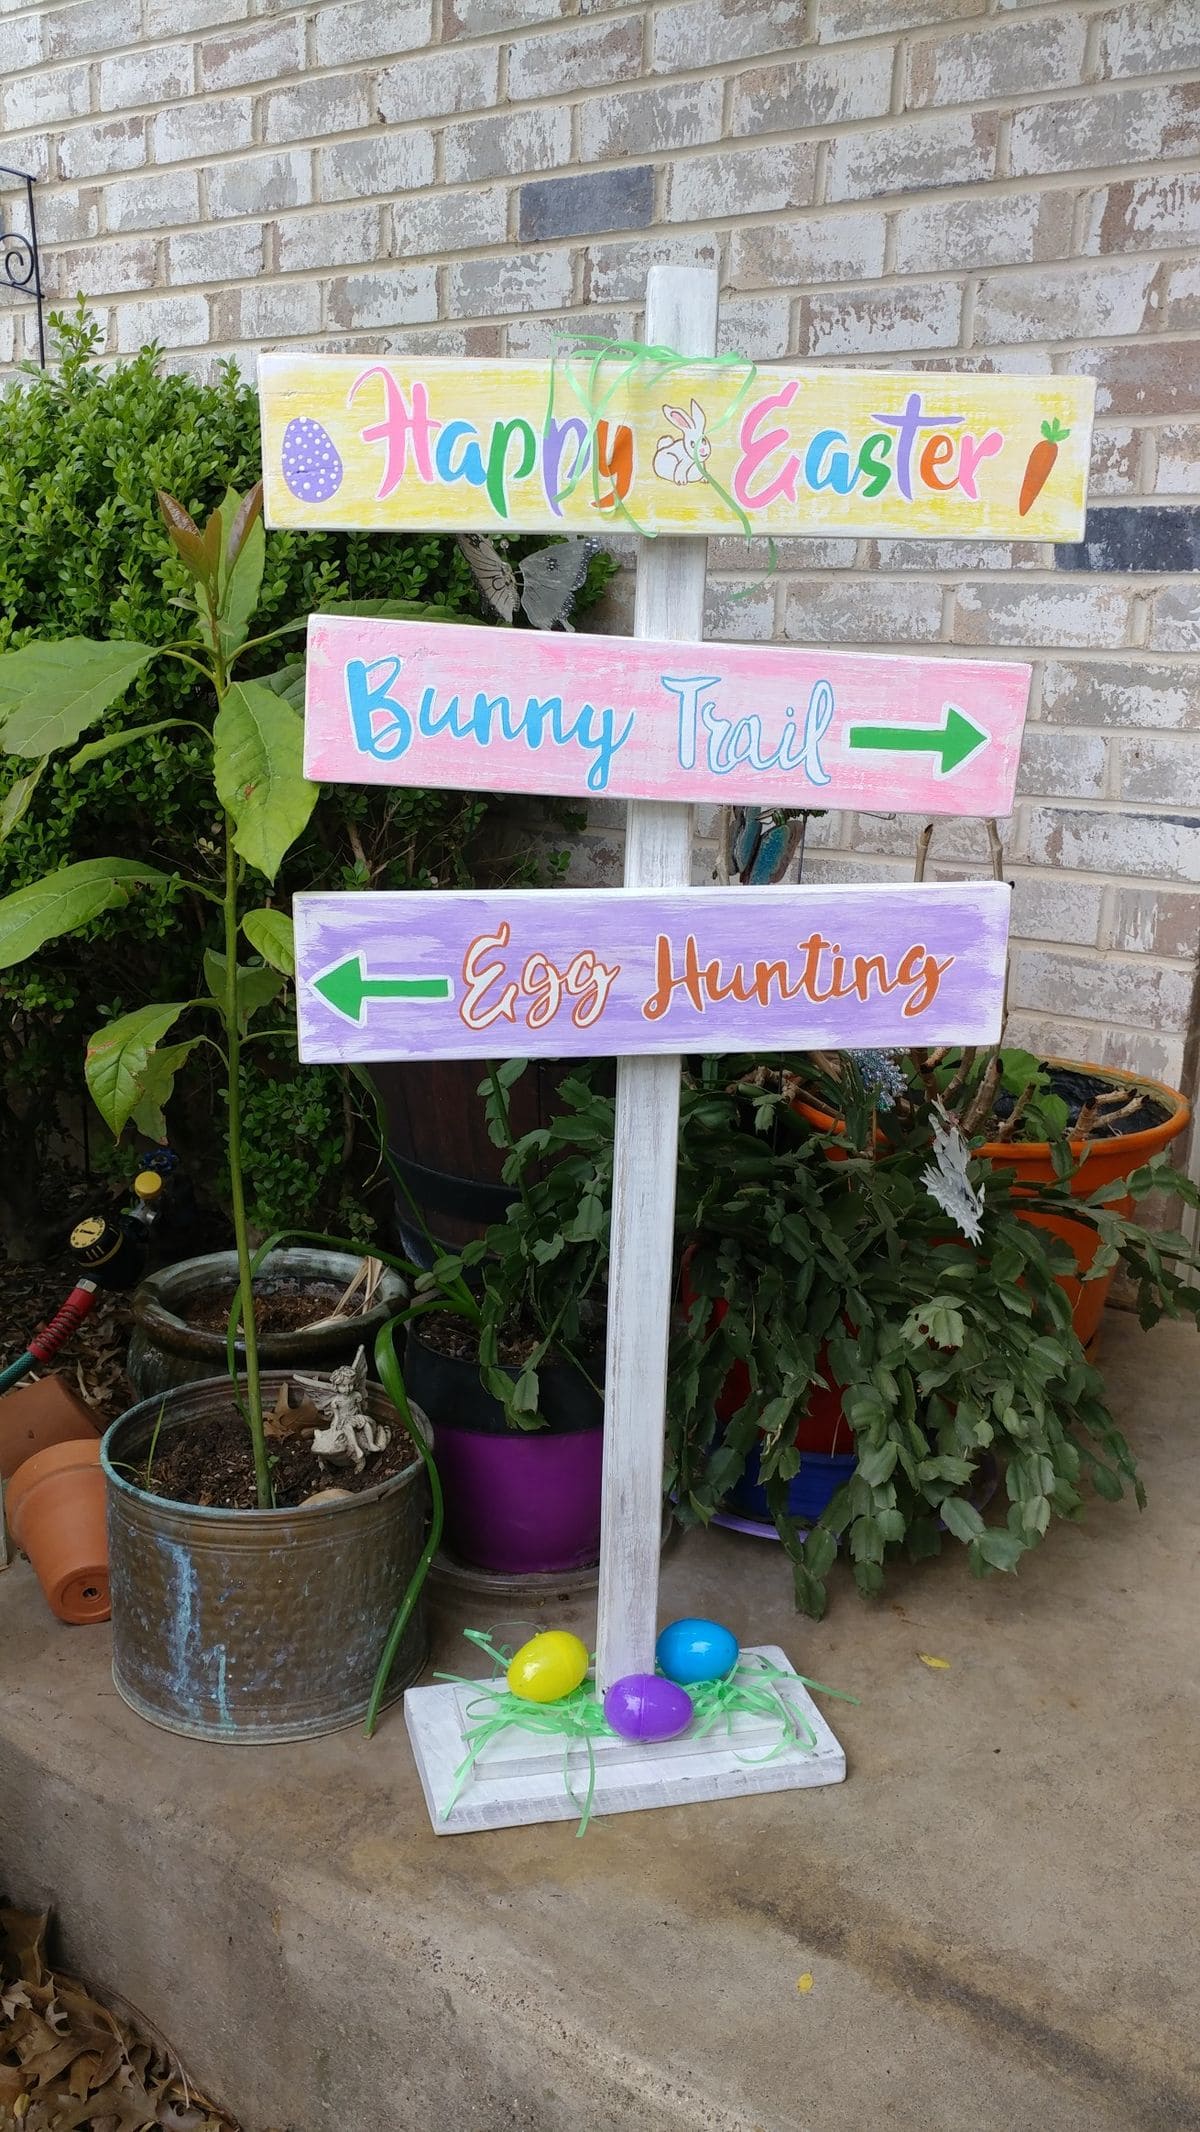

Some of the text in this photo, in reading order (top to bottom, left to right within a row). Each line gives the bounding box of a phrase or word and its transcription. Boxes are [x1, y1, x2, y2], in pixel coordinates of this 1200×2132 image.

[350, 367, 1003, 519] Happy Easter
[346, 657, 835, 791] Bunny Trail
[461, 921, 955, 1031] Egg Hunting
